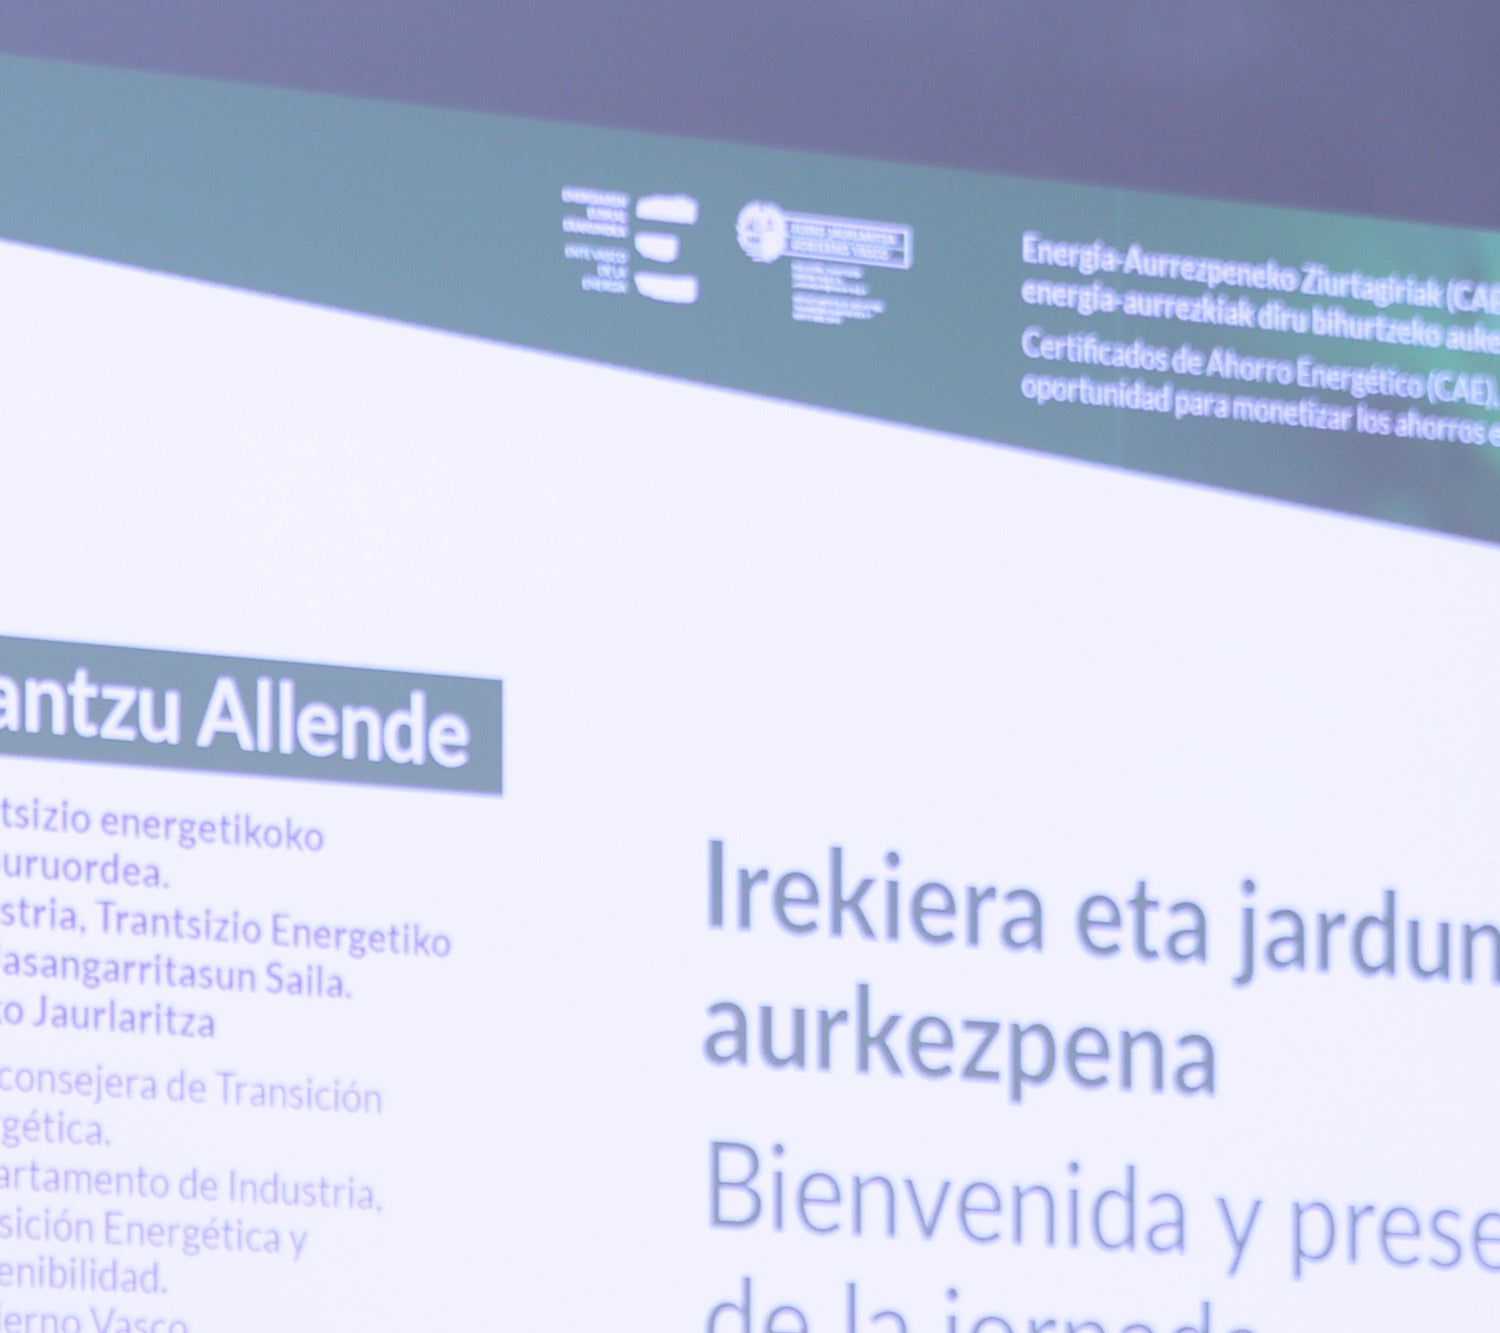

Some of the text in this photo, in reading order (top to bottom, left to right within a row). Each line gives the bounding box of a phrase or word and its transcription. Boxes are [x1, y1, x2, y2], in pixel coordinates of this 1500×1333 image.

[1300, 262, 1445, 312] Ziurtagiriak
[1258, 298, 1309, 334] diru
[1311, 303, 1441, 348] bihurtzeko
[1020, 325, 1170, 373] Certificados
[1171, 344, 1205, 376] de
[1206, 346, 1297, 386] Ahorro
[1297, 355, 1425, 400] Energético
[1020, 373, 1173, 413] oportunidad
[1175, 387, 1231, 420] para
[1232, 393, 1353, 432] monetizar
[1356, 402, 1392, 435] los
[1393, 408, 1487, 444] ahorros
[196, 676, 472, 768] Allende
[100, 811, 324, 853] energetikoko
[707, 839, 1044, 951] Irekiera
[1075, 878, 1207, 962] eta
[97, 900, 262, 945] Trantsizio
[272, 913, 452, 959] Energetiko
[265, 961, 353, 999] Saila.
[33, 995, 215, 1038] Jaurlaritza
[704, 983, 1216, 1101] aurkezpena
[167, 1070, 206, 1103] de
[215, 1072, 382, 1114] Transición
[178, 1168, 217, 1200] de
[709, 1139, 1187, 1256] Bienvenida
[1219, 1194, 1263, 1277] y
[105, 1211, 280, 1256] Energética
[290, 1230, 308, 1262] y
